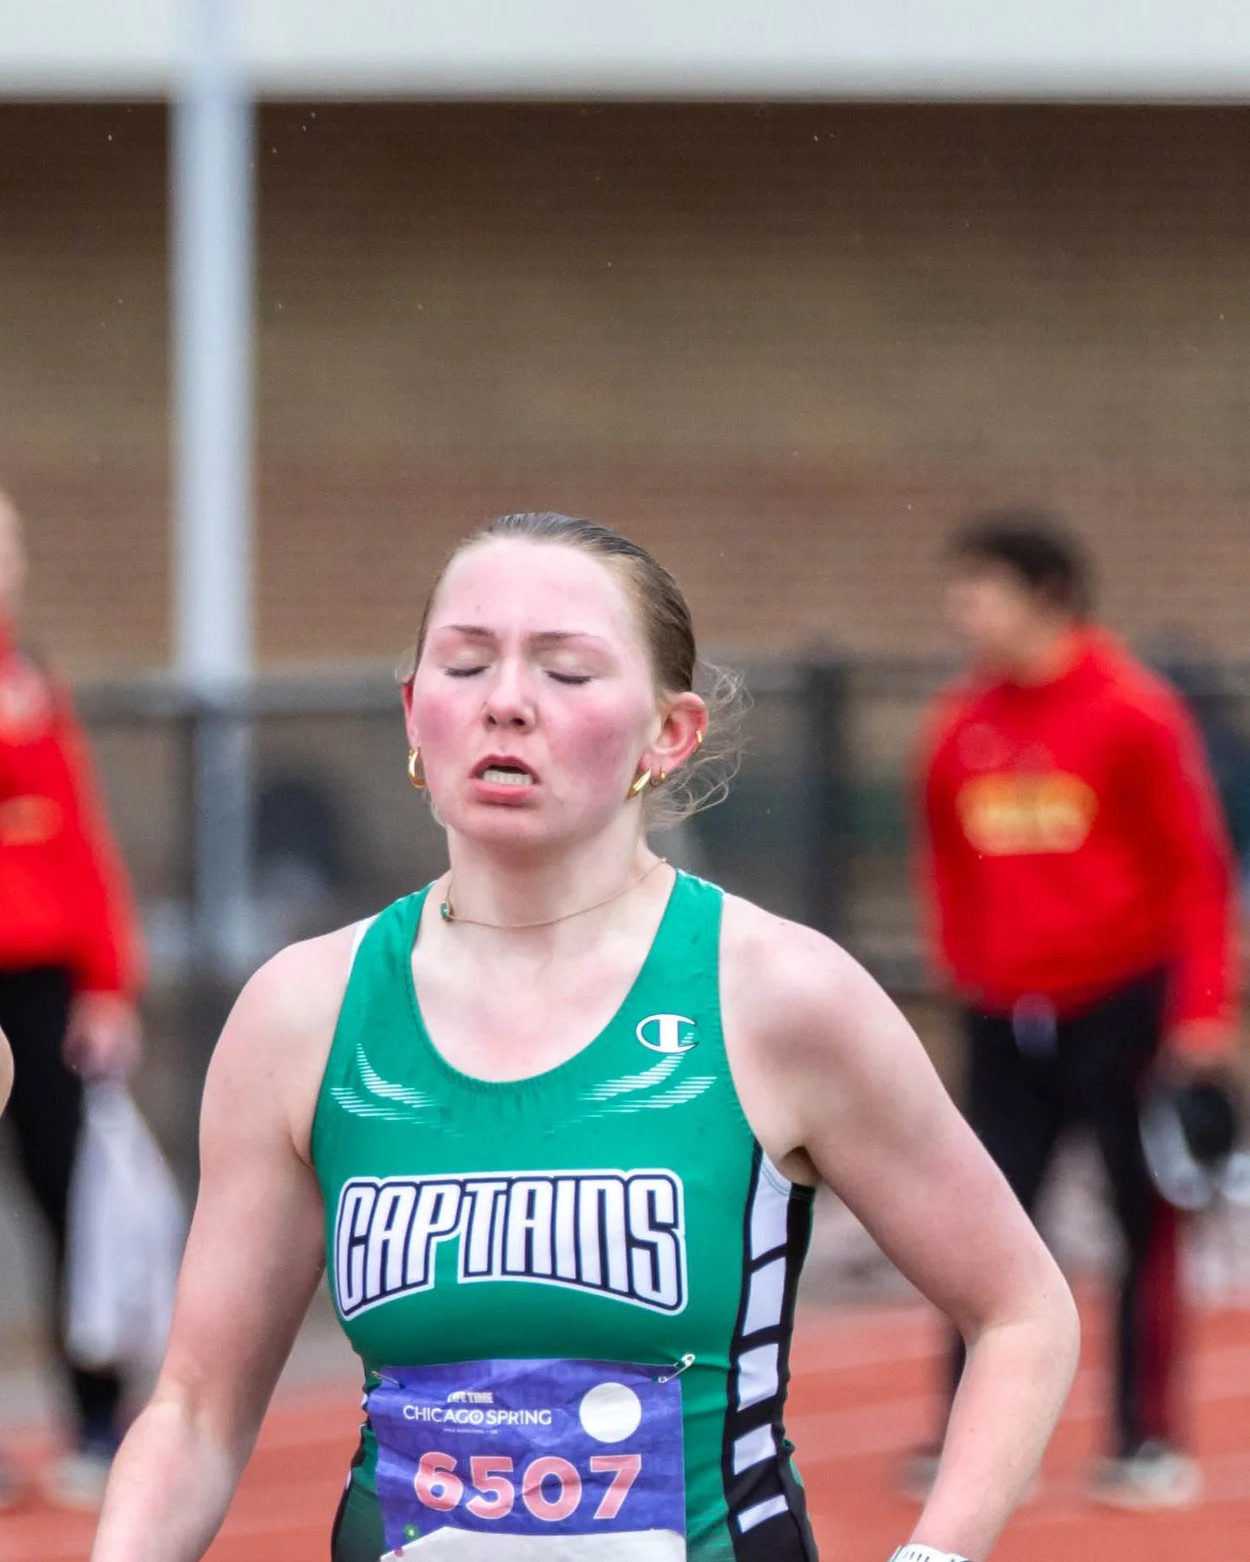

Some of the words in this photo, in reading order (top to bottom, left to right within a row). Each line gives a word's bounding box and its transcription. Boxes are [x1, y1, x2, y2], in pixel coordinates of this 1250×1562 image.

[334, 1168, 688, 1321] CAPTAINS
[402, 1404, 484, 1426] CHICAGO
[485, 1408, 552, 1426] SPRING
[414, 1451, 642, 1522] 6507
